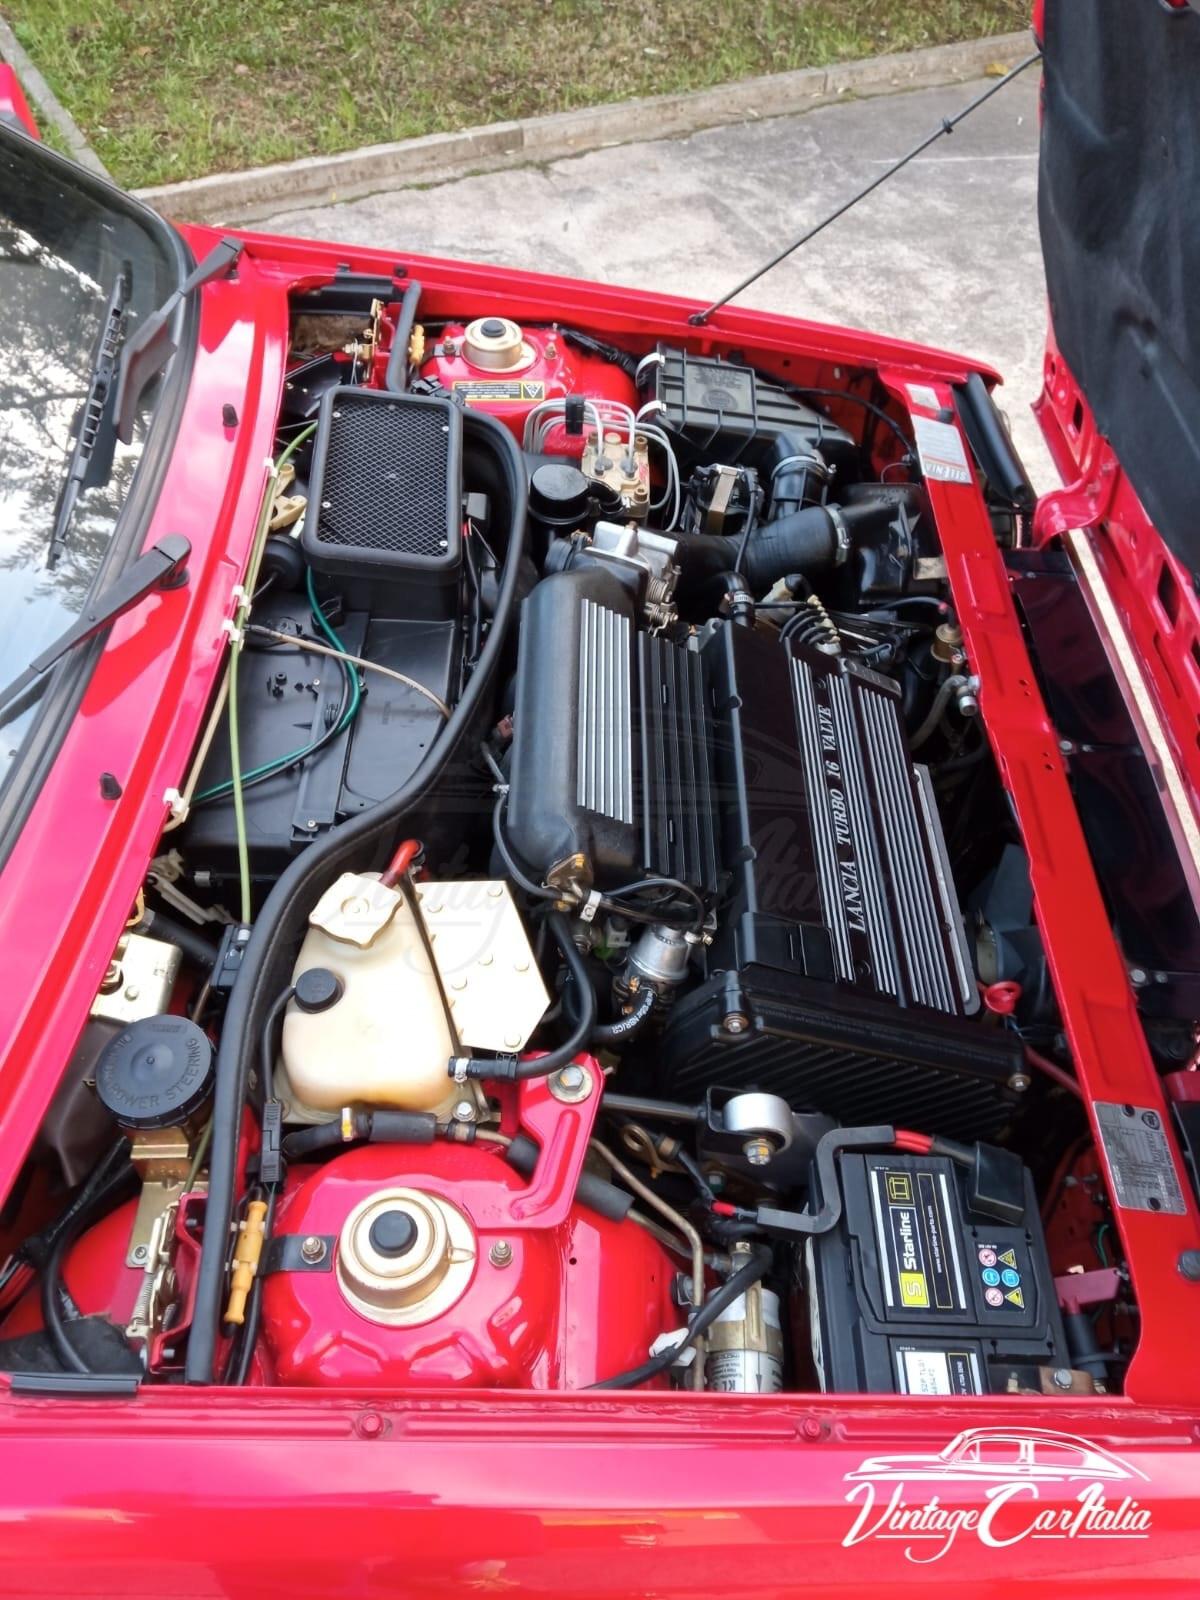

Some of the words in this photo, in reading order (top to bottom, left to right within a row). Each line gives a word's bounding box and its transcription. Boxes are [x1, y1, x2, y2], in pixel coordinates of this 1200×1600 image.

[818, 704, 836, 751] VALVE
[826, 760, 841, 779] 16
[830, 788, 851, 846] TURBO
[840, 861, 866, 933] LANCIA
[110, 1085, 161, 1109] POWER
[166, 1037, 201, 1101] STEERING
[900, 1211, 917, 1271] Starline
